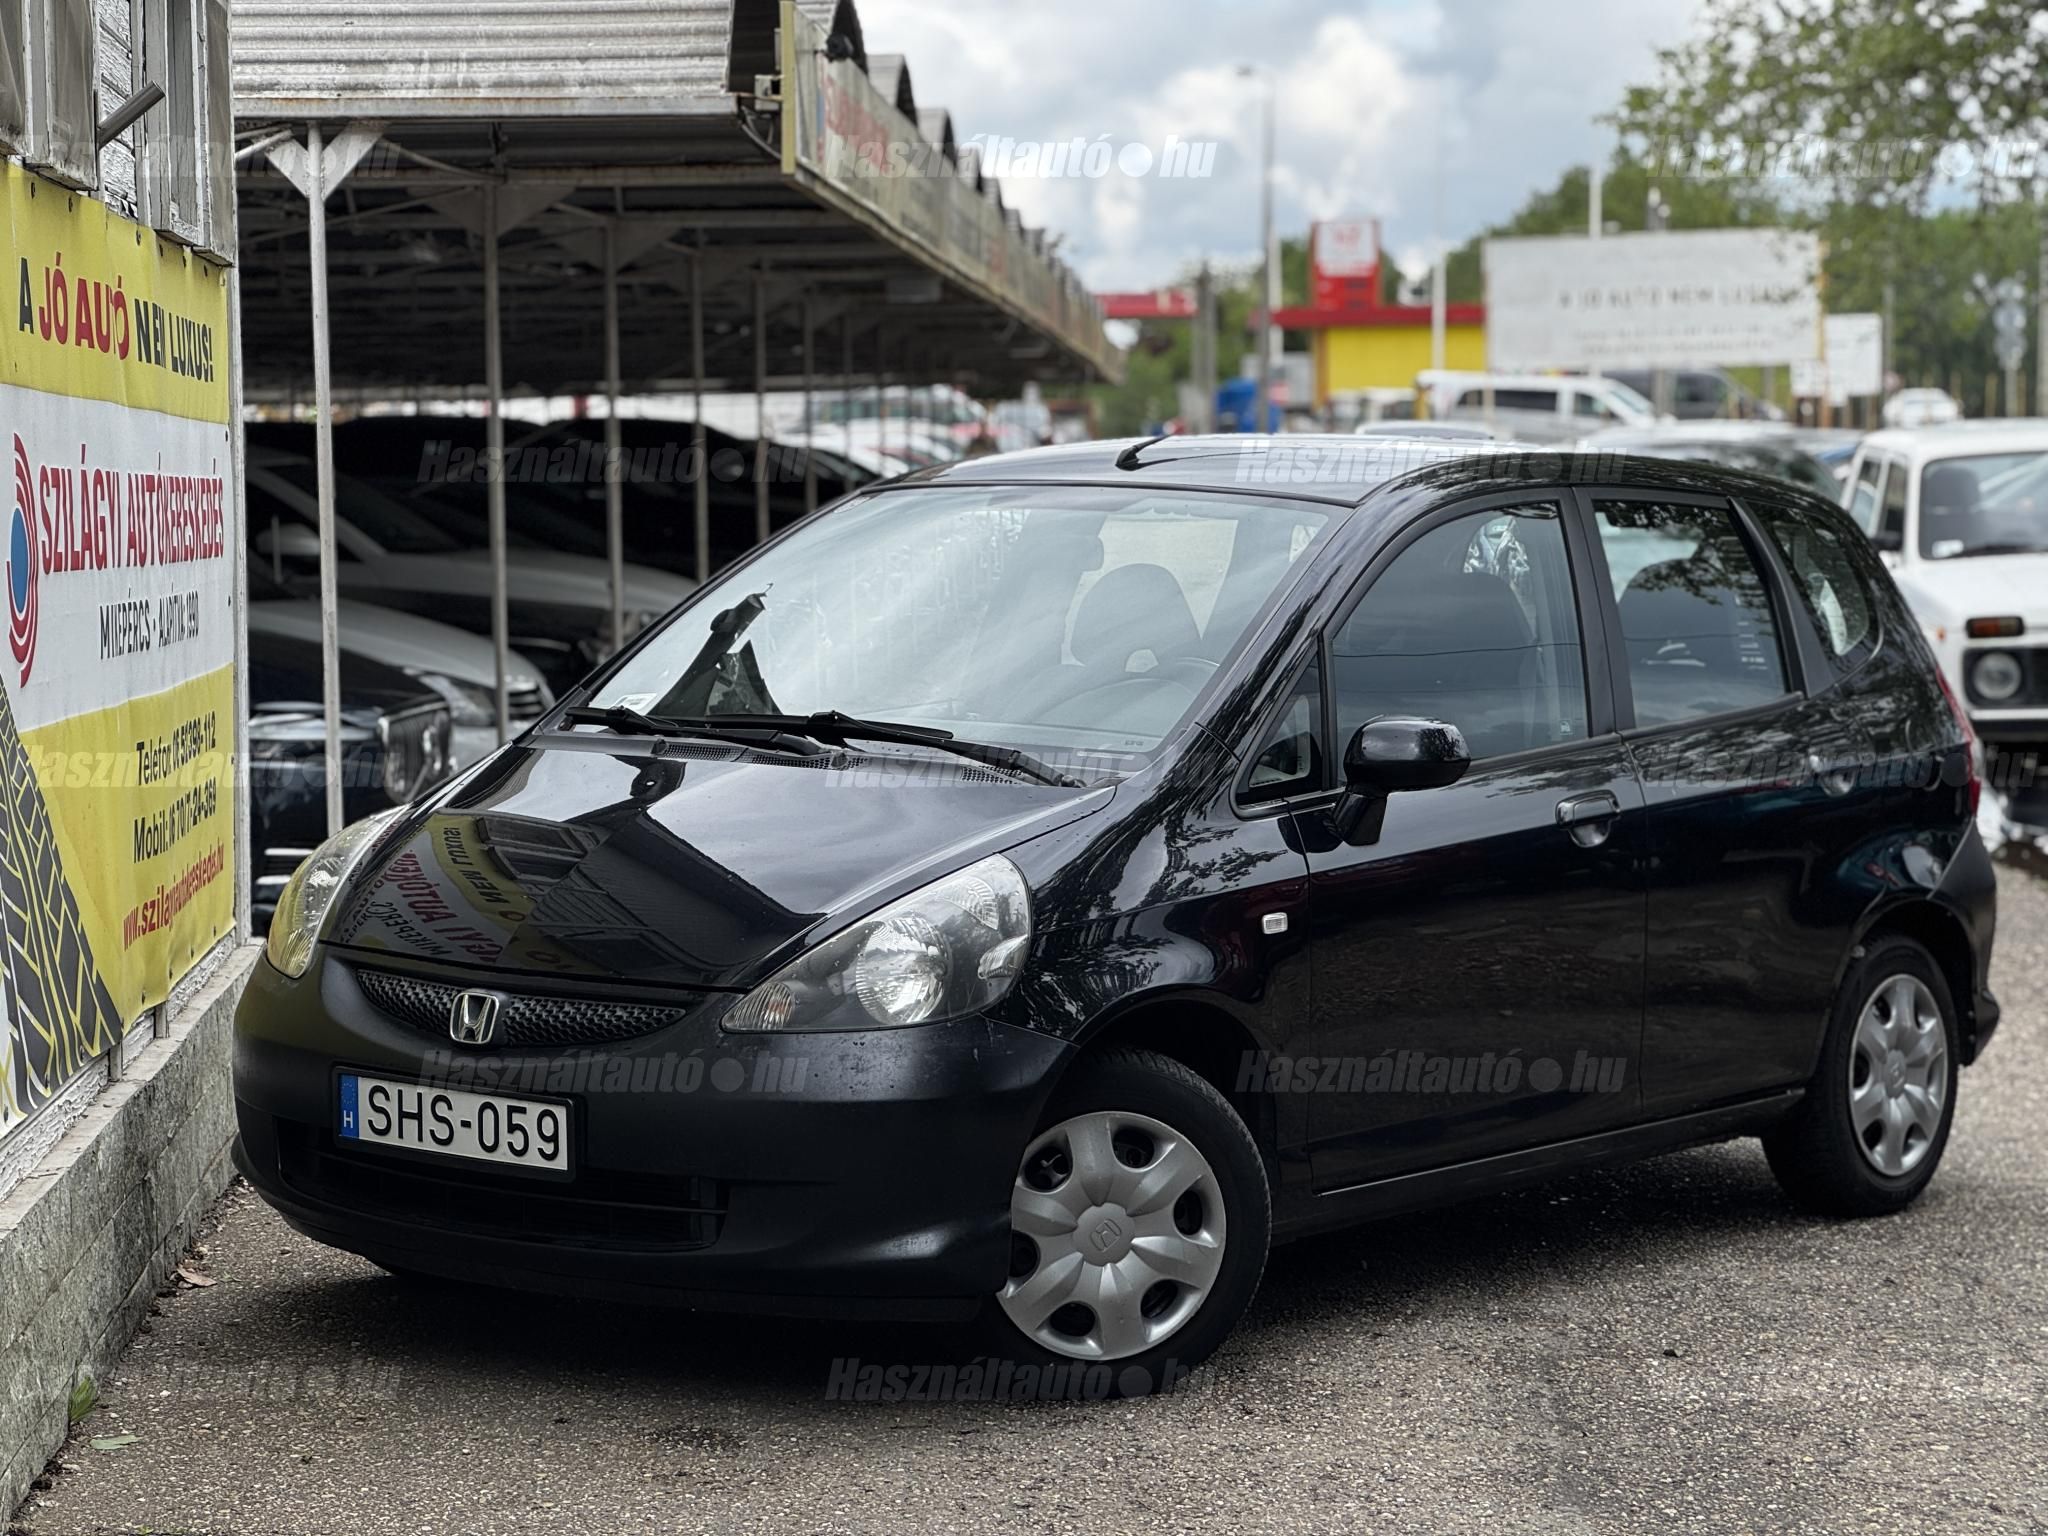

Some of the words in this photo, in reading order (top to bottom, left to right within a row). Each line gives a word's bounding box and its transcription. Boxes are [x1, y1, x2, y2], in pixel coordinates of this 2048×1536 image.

[19, 257, 34, 334] A
[39, 251, 68, 345] JÓ
[169, 312, 214, 382] LUXUS!
[39, 443, 121, 575] SZILÁGYI
[126, 451, 224, 567] AUTÓKERESKEDÉS
[133, 808, 168, 864] Mobil:
[343, 1110, 354, 1129] H
[367, 1084, 560, 1162] SHS-059
